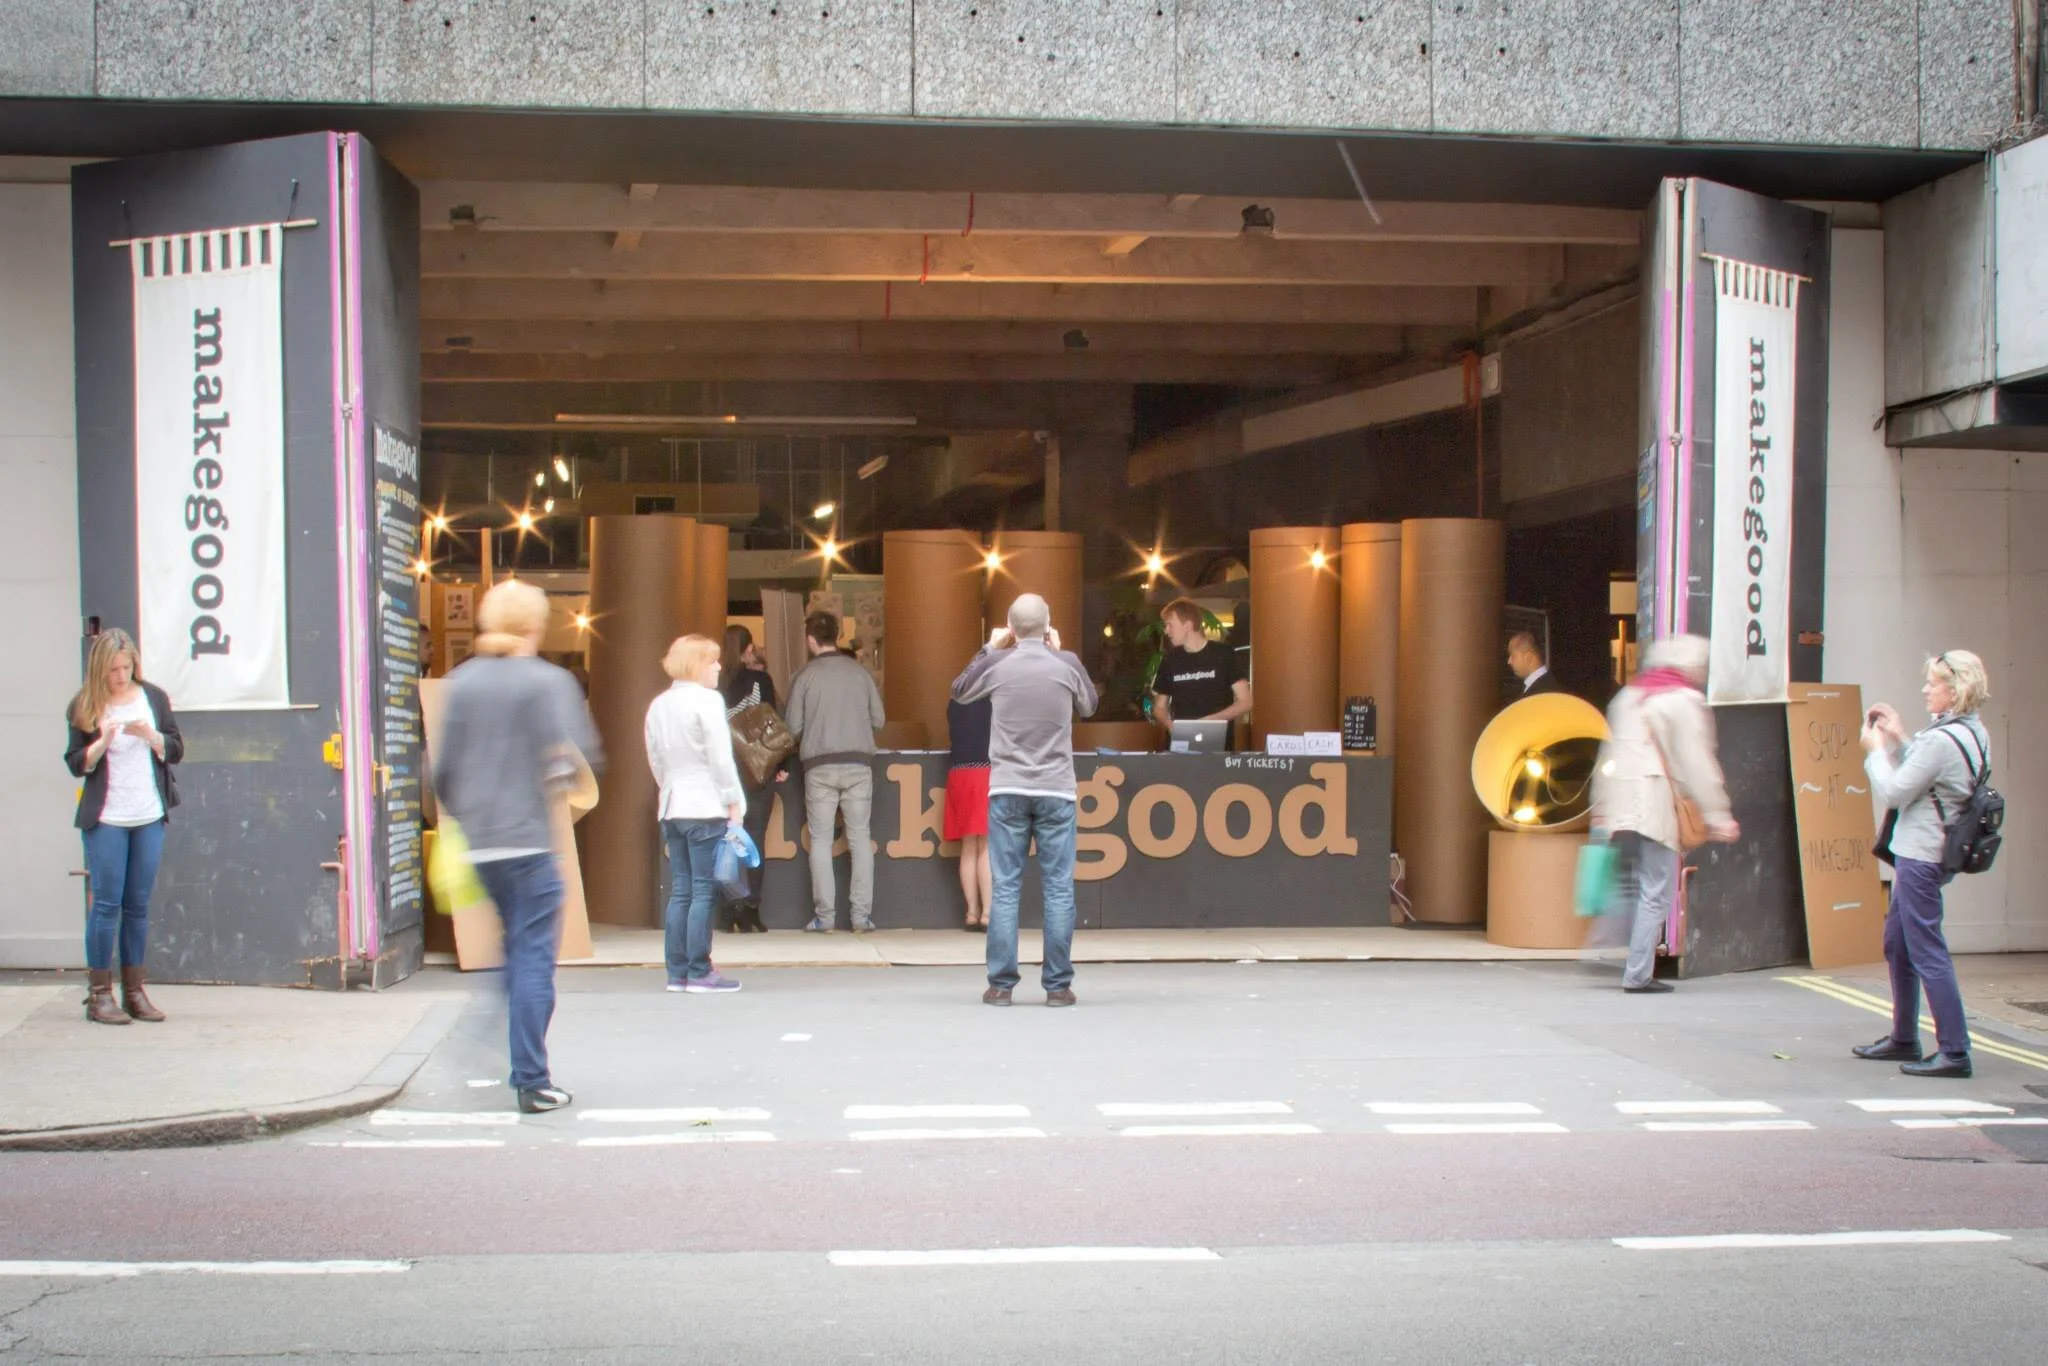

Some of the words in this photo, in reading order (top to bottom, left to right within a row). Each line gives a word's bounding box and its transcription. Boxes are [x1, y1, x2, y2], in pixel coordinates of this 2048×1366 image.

[185, 306, 230, 661] makegood
[1742, 337, 1772, 661] makegood
[1173, 669, 1216, 682] makegood
[1224, 756, 1242, 769] BUY
[1246, 758, 1287, 770] TICKETS
[1808, 720, 1848, 762] SHOP
[764, 762, 1359, 882] kgood
